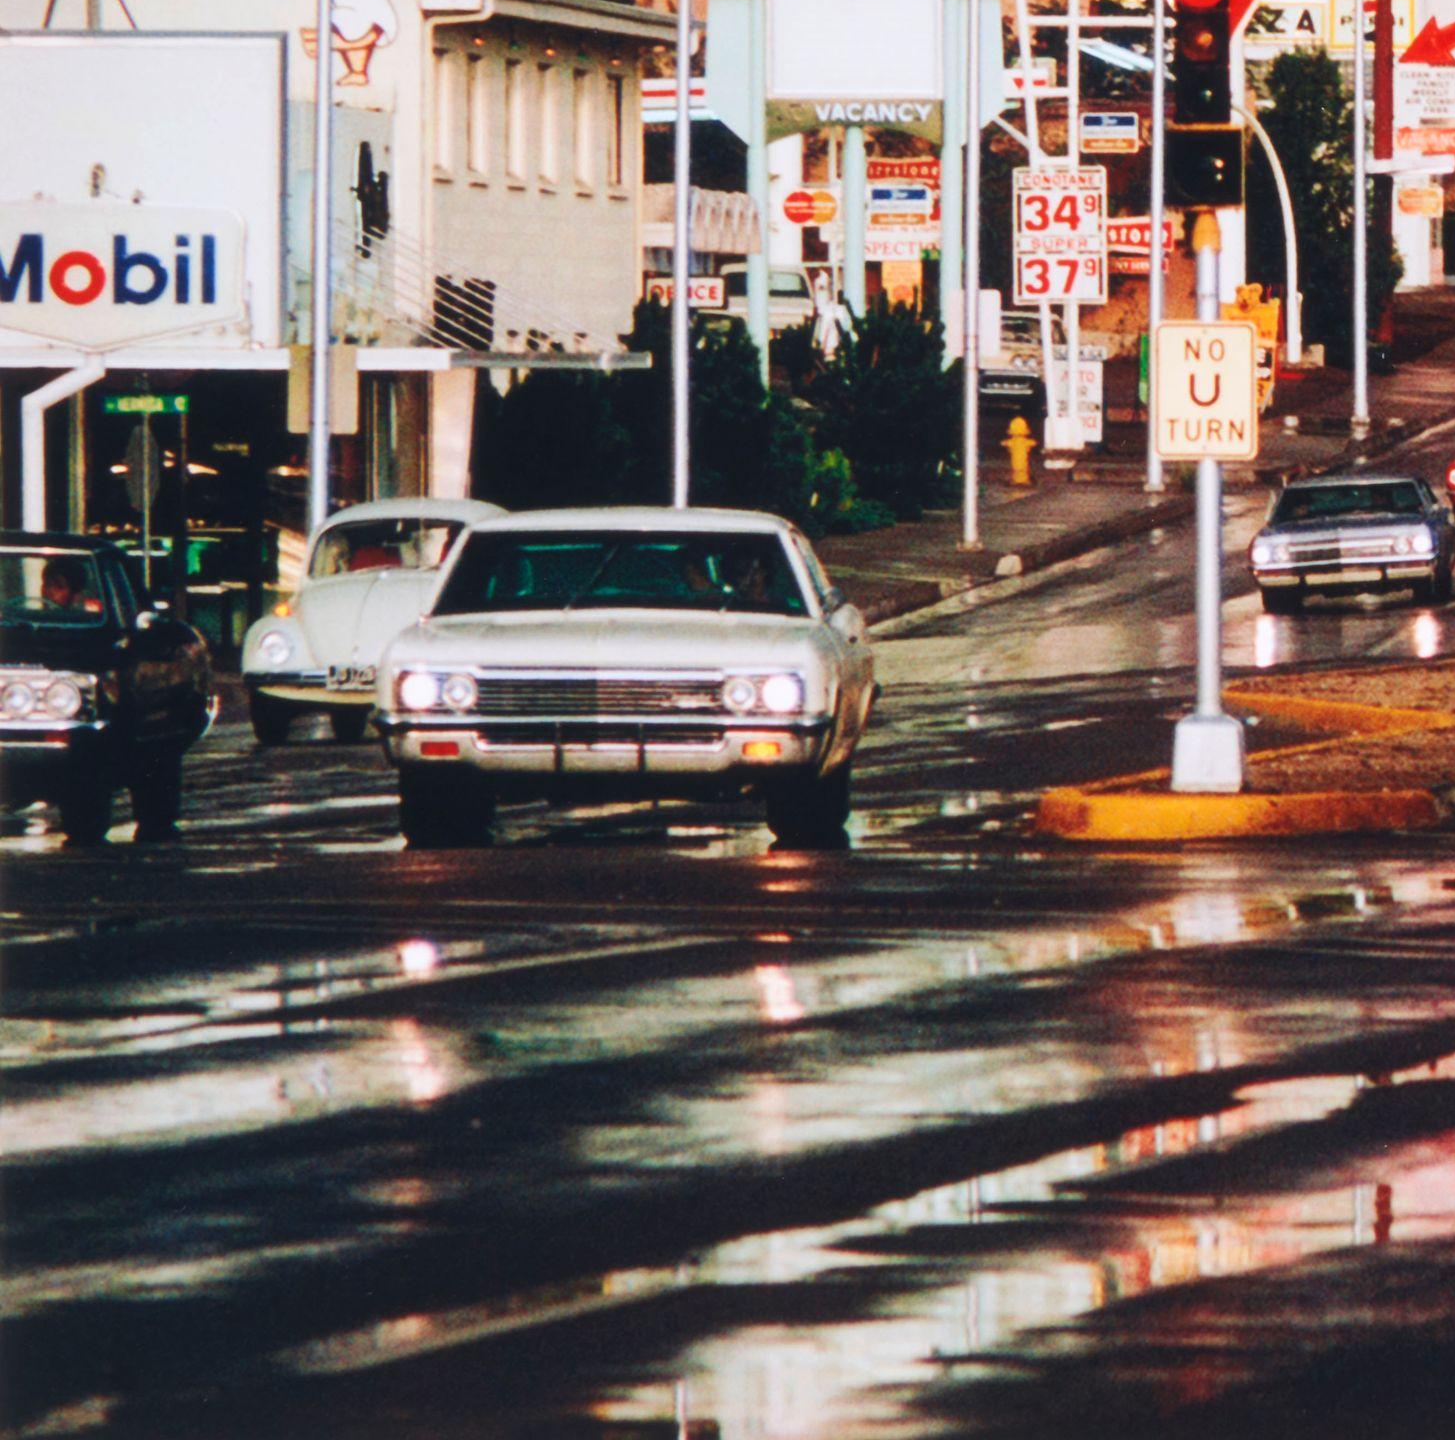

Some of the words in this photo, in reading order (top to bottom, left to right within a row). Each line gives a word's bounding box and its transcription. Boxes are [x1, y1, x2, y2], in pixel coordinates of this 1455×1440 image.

[815, 102, 933, 123] VACANCY
[1183, 338, 1227, 362] NO
[1189, 373, 1221, 407] U
[1166, 418, 1245, 442] TURN
